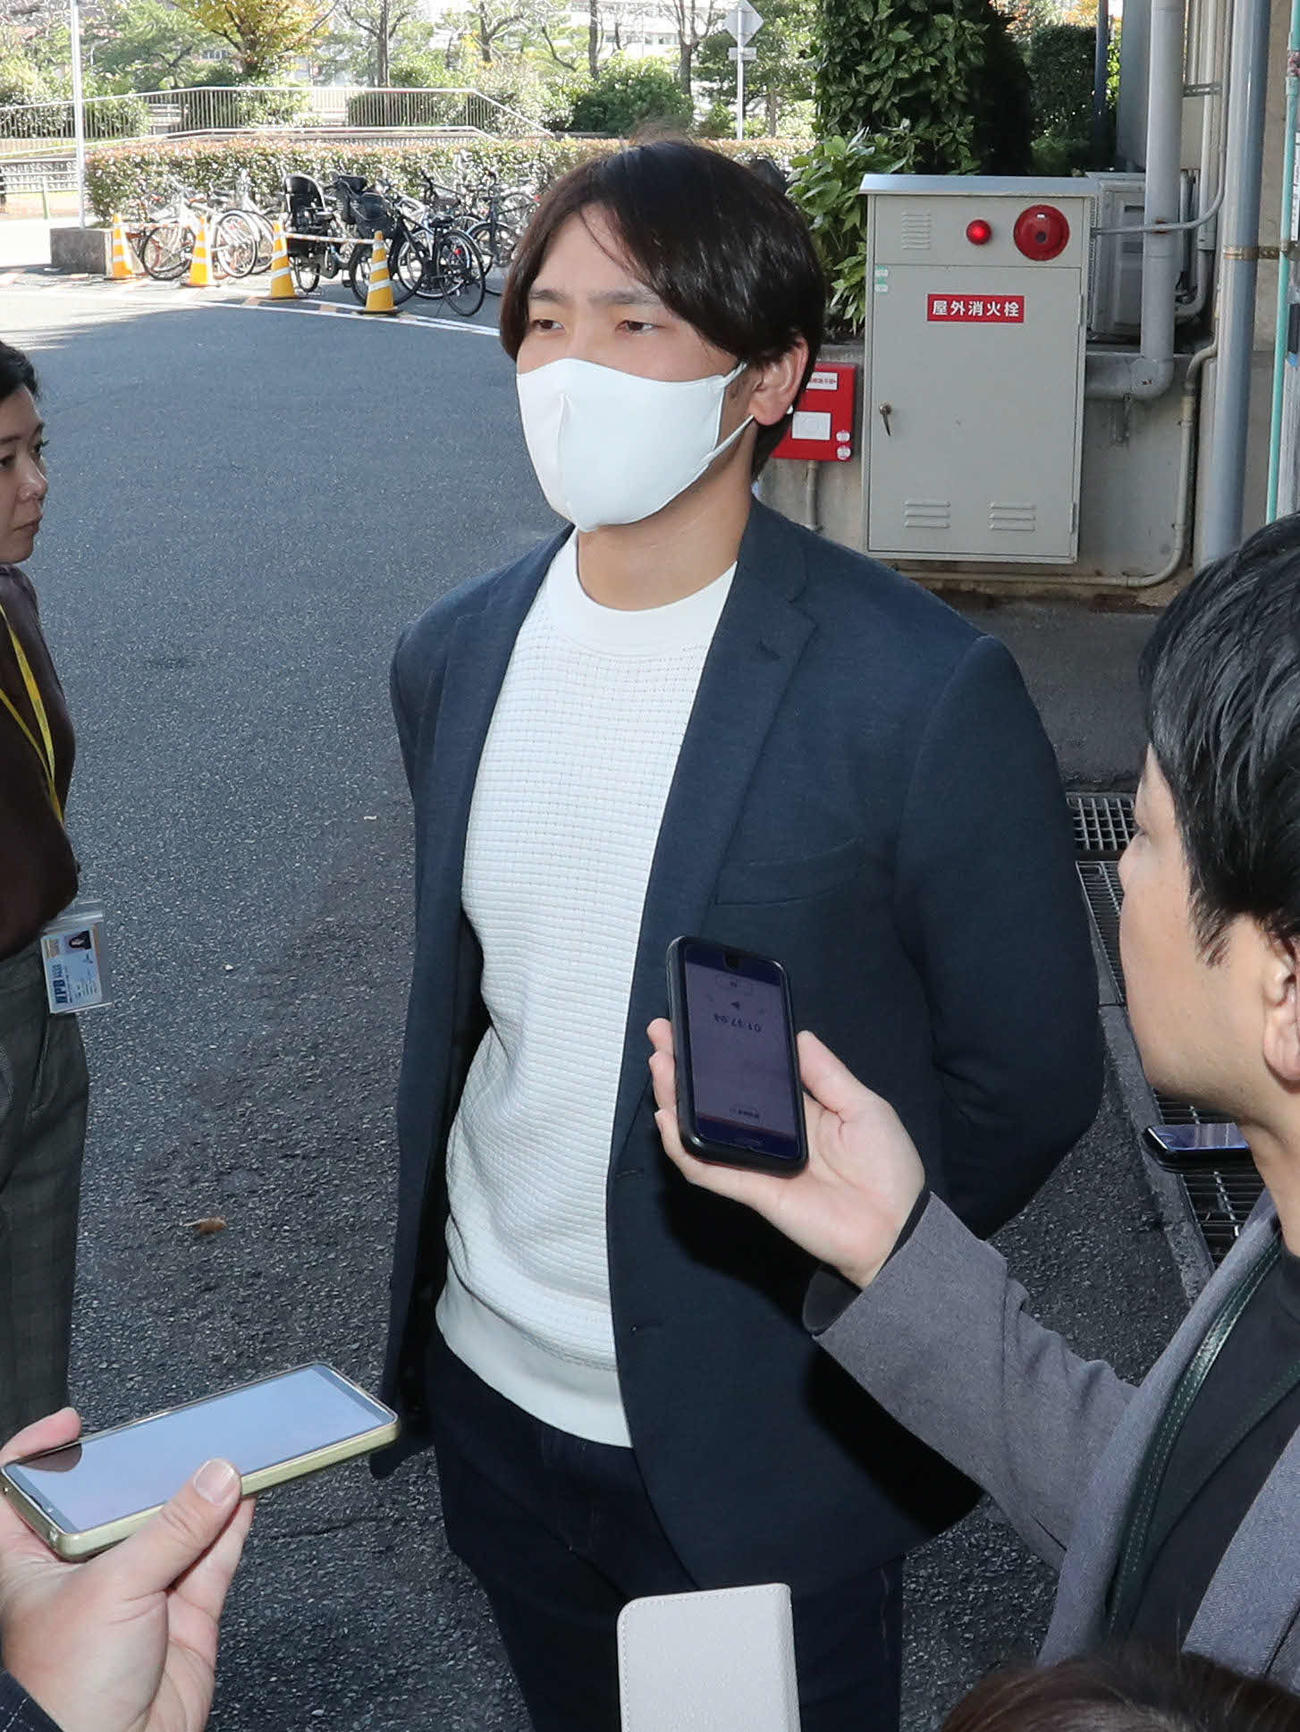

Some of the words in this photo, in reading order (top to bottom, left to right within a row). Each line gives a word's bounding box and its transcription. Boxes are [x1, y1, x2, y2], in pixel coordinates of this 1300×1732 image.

[932, 300, 1019, 317] 屋外消火栓
